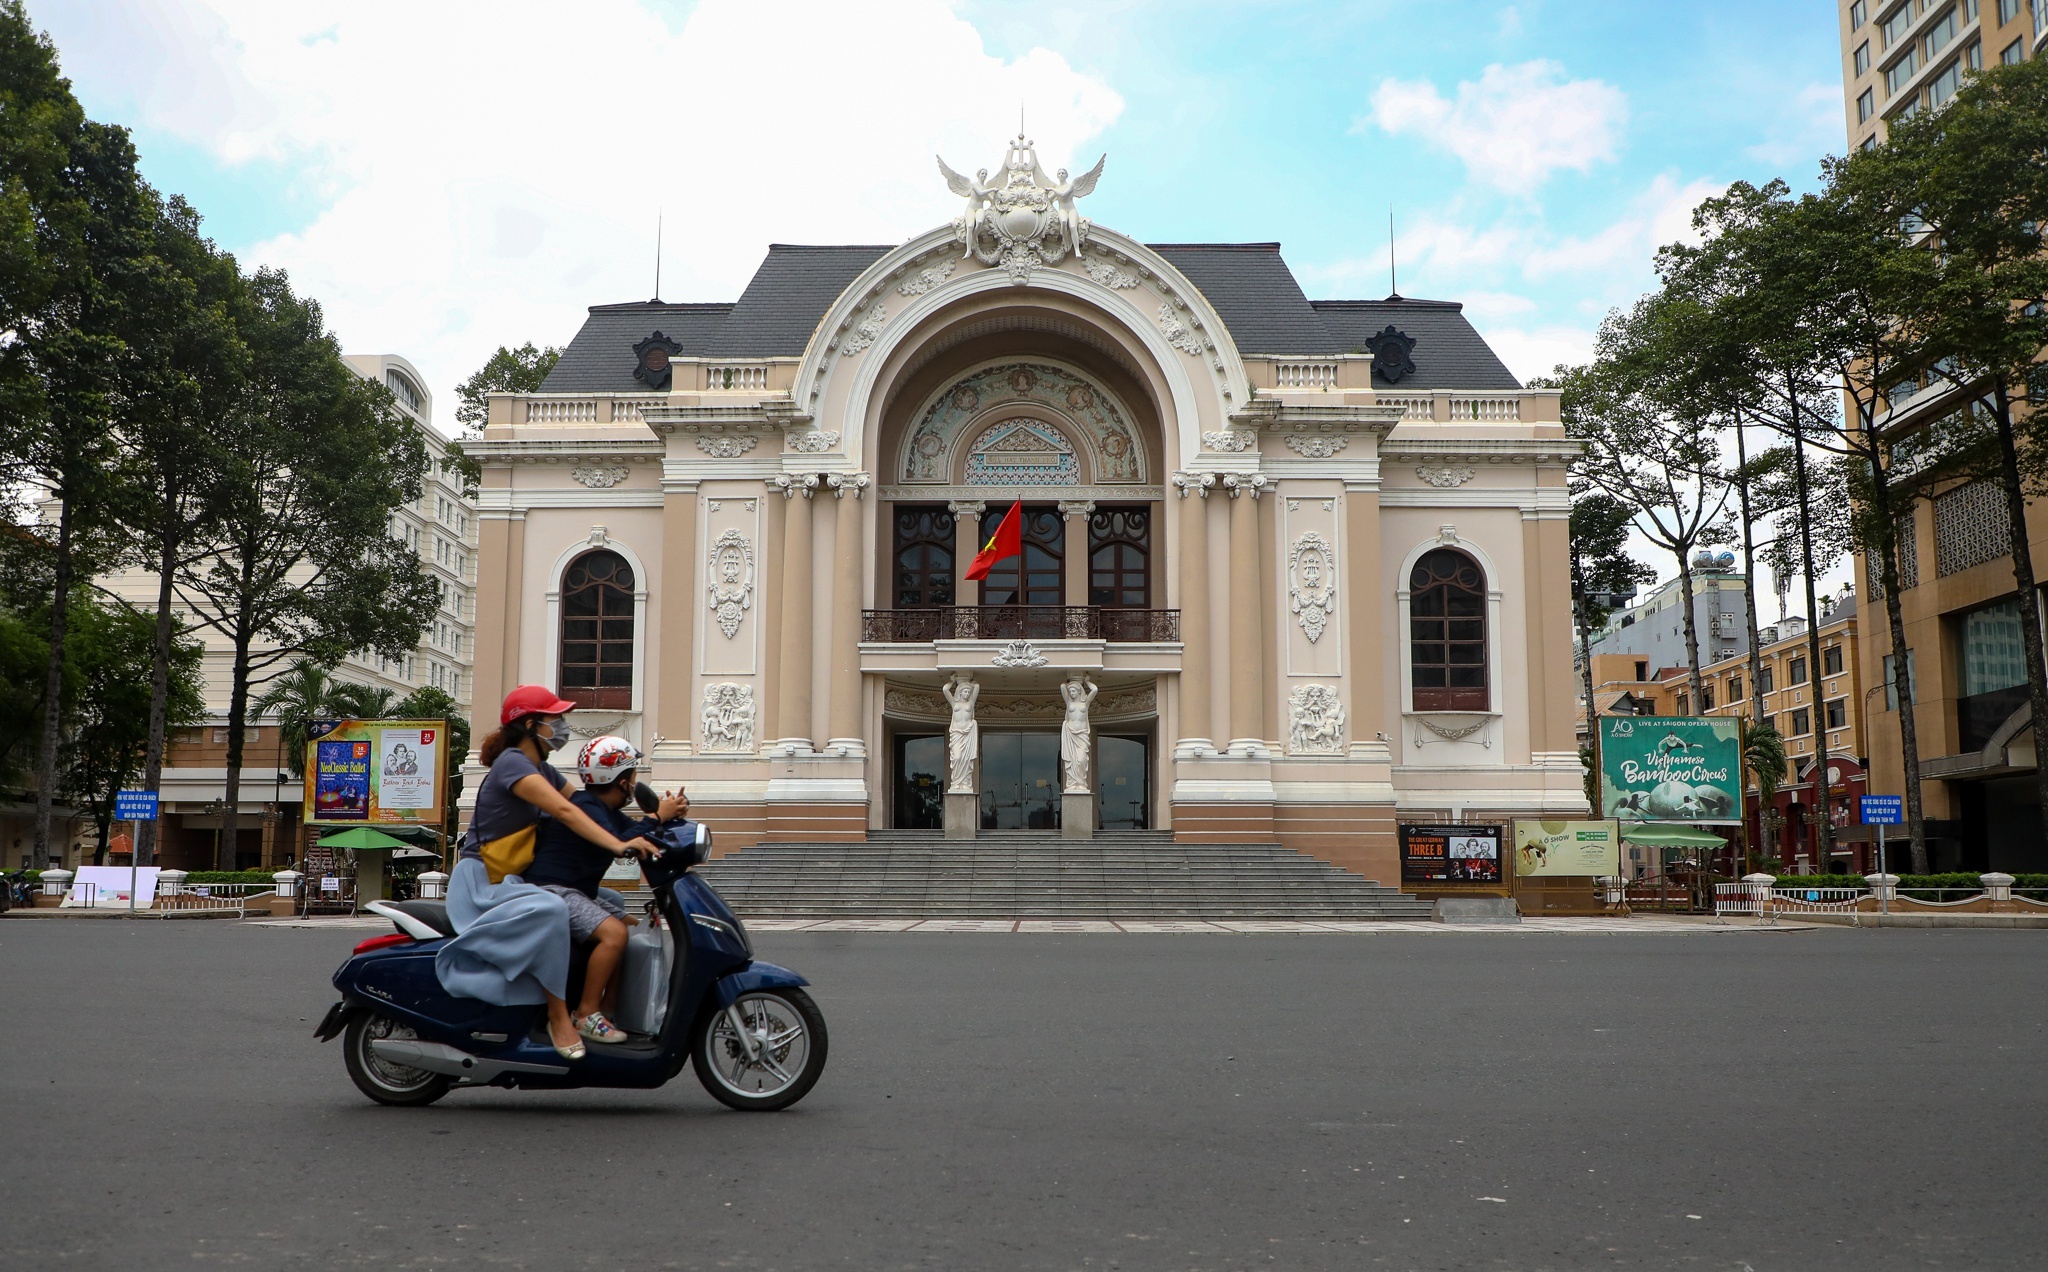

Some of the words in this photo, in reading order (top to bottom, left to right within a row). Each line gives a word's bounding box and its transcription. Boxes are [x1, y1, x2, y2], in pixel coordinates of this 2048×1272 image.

[1644, 750, 1705, 768] Vietnamese
[320, 762, 348, 773] NeoClassic
[350, 761, 366, 773] Ballet
[1620, 760, 1690, 784] Bamboo
[1692, 765, 1728, 782] Circus
[1550, 834, 1570, 843] SHOW
[1408, 844, 1435, 856] THREE
